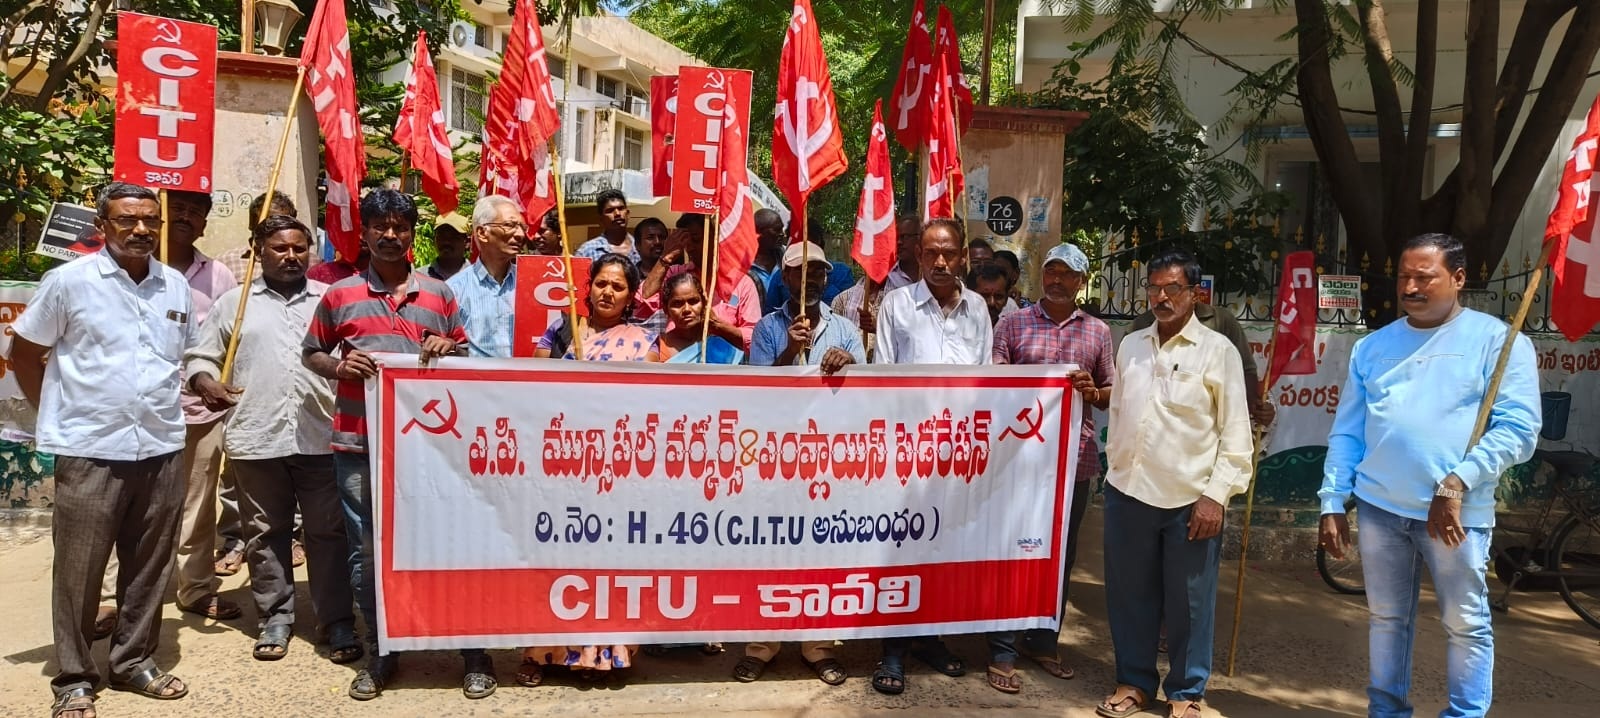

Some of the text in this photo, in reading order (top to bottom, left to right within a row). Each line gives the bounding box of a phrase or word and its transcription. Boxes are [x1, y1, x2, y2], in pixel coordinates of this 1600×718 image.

[138, 46, 200, 170] CITU
[144, 171, 184, 186] కావలి
[694, 198, 713, 210] కావ
[991, 203, 1013, 218] 76
[992, 221, 1015, 232] 114
[42, 244, 56, 254] NO
[1280, 383, 1340, 414] పరిరక్షి
[549, 574, 698, 621] CITU
[757, 573, 922, 618] కావలి
